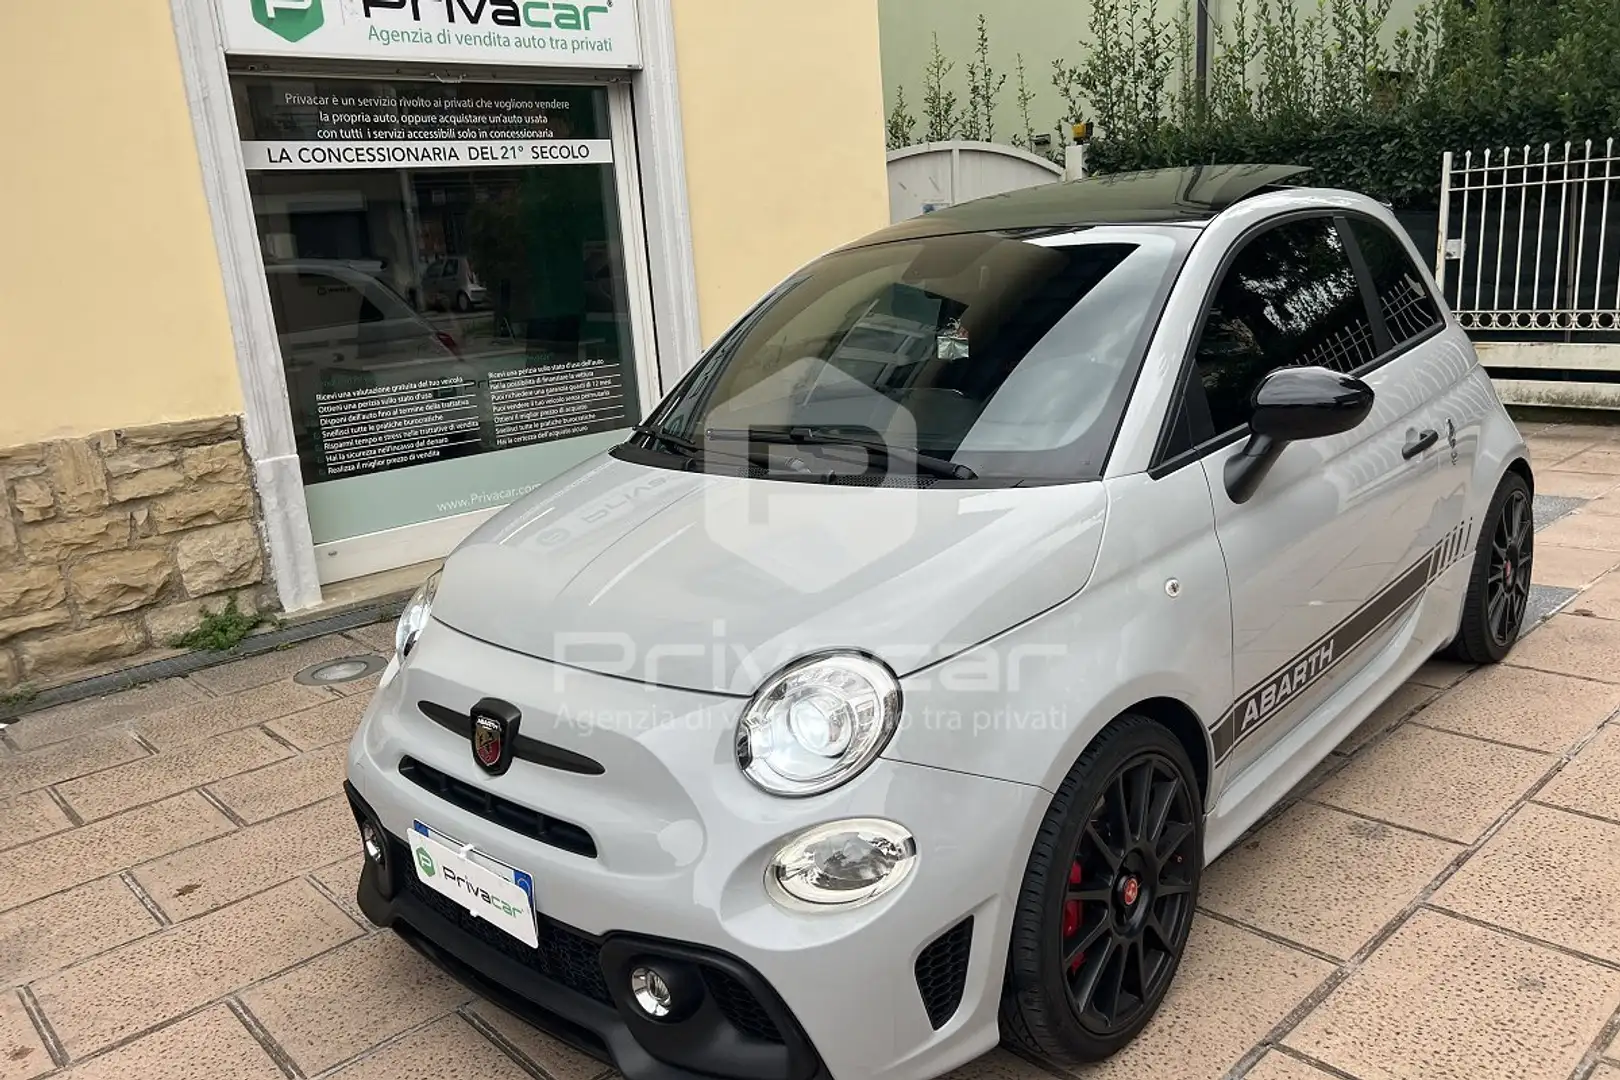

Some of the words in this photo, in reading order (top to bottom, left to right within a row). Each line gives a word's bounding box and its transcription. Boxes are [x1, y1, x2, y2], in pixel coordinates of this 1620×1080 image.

[368, 24, 432, 46] Agenzia
[437, 28, 451, 45] di
[455, 31, 511, 48] vendita
[514, 36, 546, 50] auto
[549, 36, 568, 50] tra
[572, 36, 613, 53] privati
[284, 93, 329, 106] Privacar
[341, 97, 355, 106] un
[357, 96, 397, 107] servizio
[399, 96, 431, 108] rivolto
[433, 97, 442, 108] ai
[443, 97, 474, 110] privati
[475, 97, 493, 109] che
[493, 98, 534, 111] vogliono
[534, 99, 570, 110] vendere
[319, 110, 330, 122] la
[331, 112, 371, 124] propria
[400, 114, 437, 125] oppure
[438, 114, 487, 126] acquistare
[525, 114, 548, 124] usata
[317, 129, 338, 139] con
[339, 128, 363, 139] tutti
[372, 128, 405, 139] servizi
[407, 128, 456, 139] accessibili
[457, 128, 477, 139] solo
[479, 128, 488, 139] in
[489, 129, 554, 139] concessionaria
[267, 147, 293, 163] LA
[298, 146, 460, 163] CONCESSIONARIA
[468, 146, 498, 161] DEL
[531, 144, 590, 160] SECOLO
[1240, 638, 1334, 732] ABARTH
[441, 865, 523, 918] Privacar
